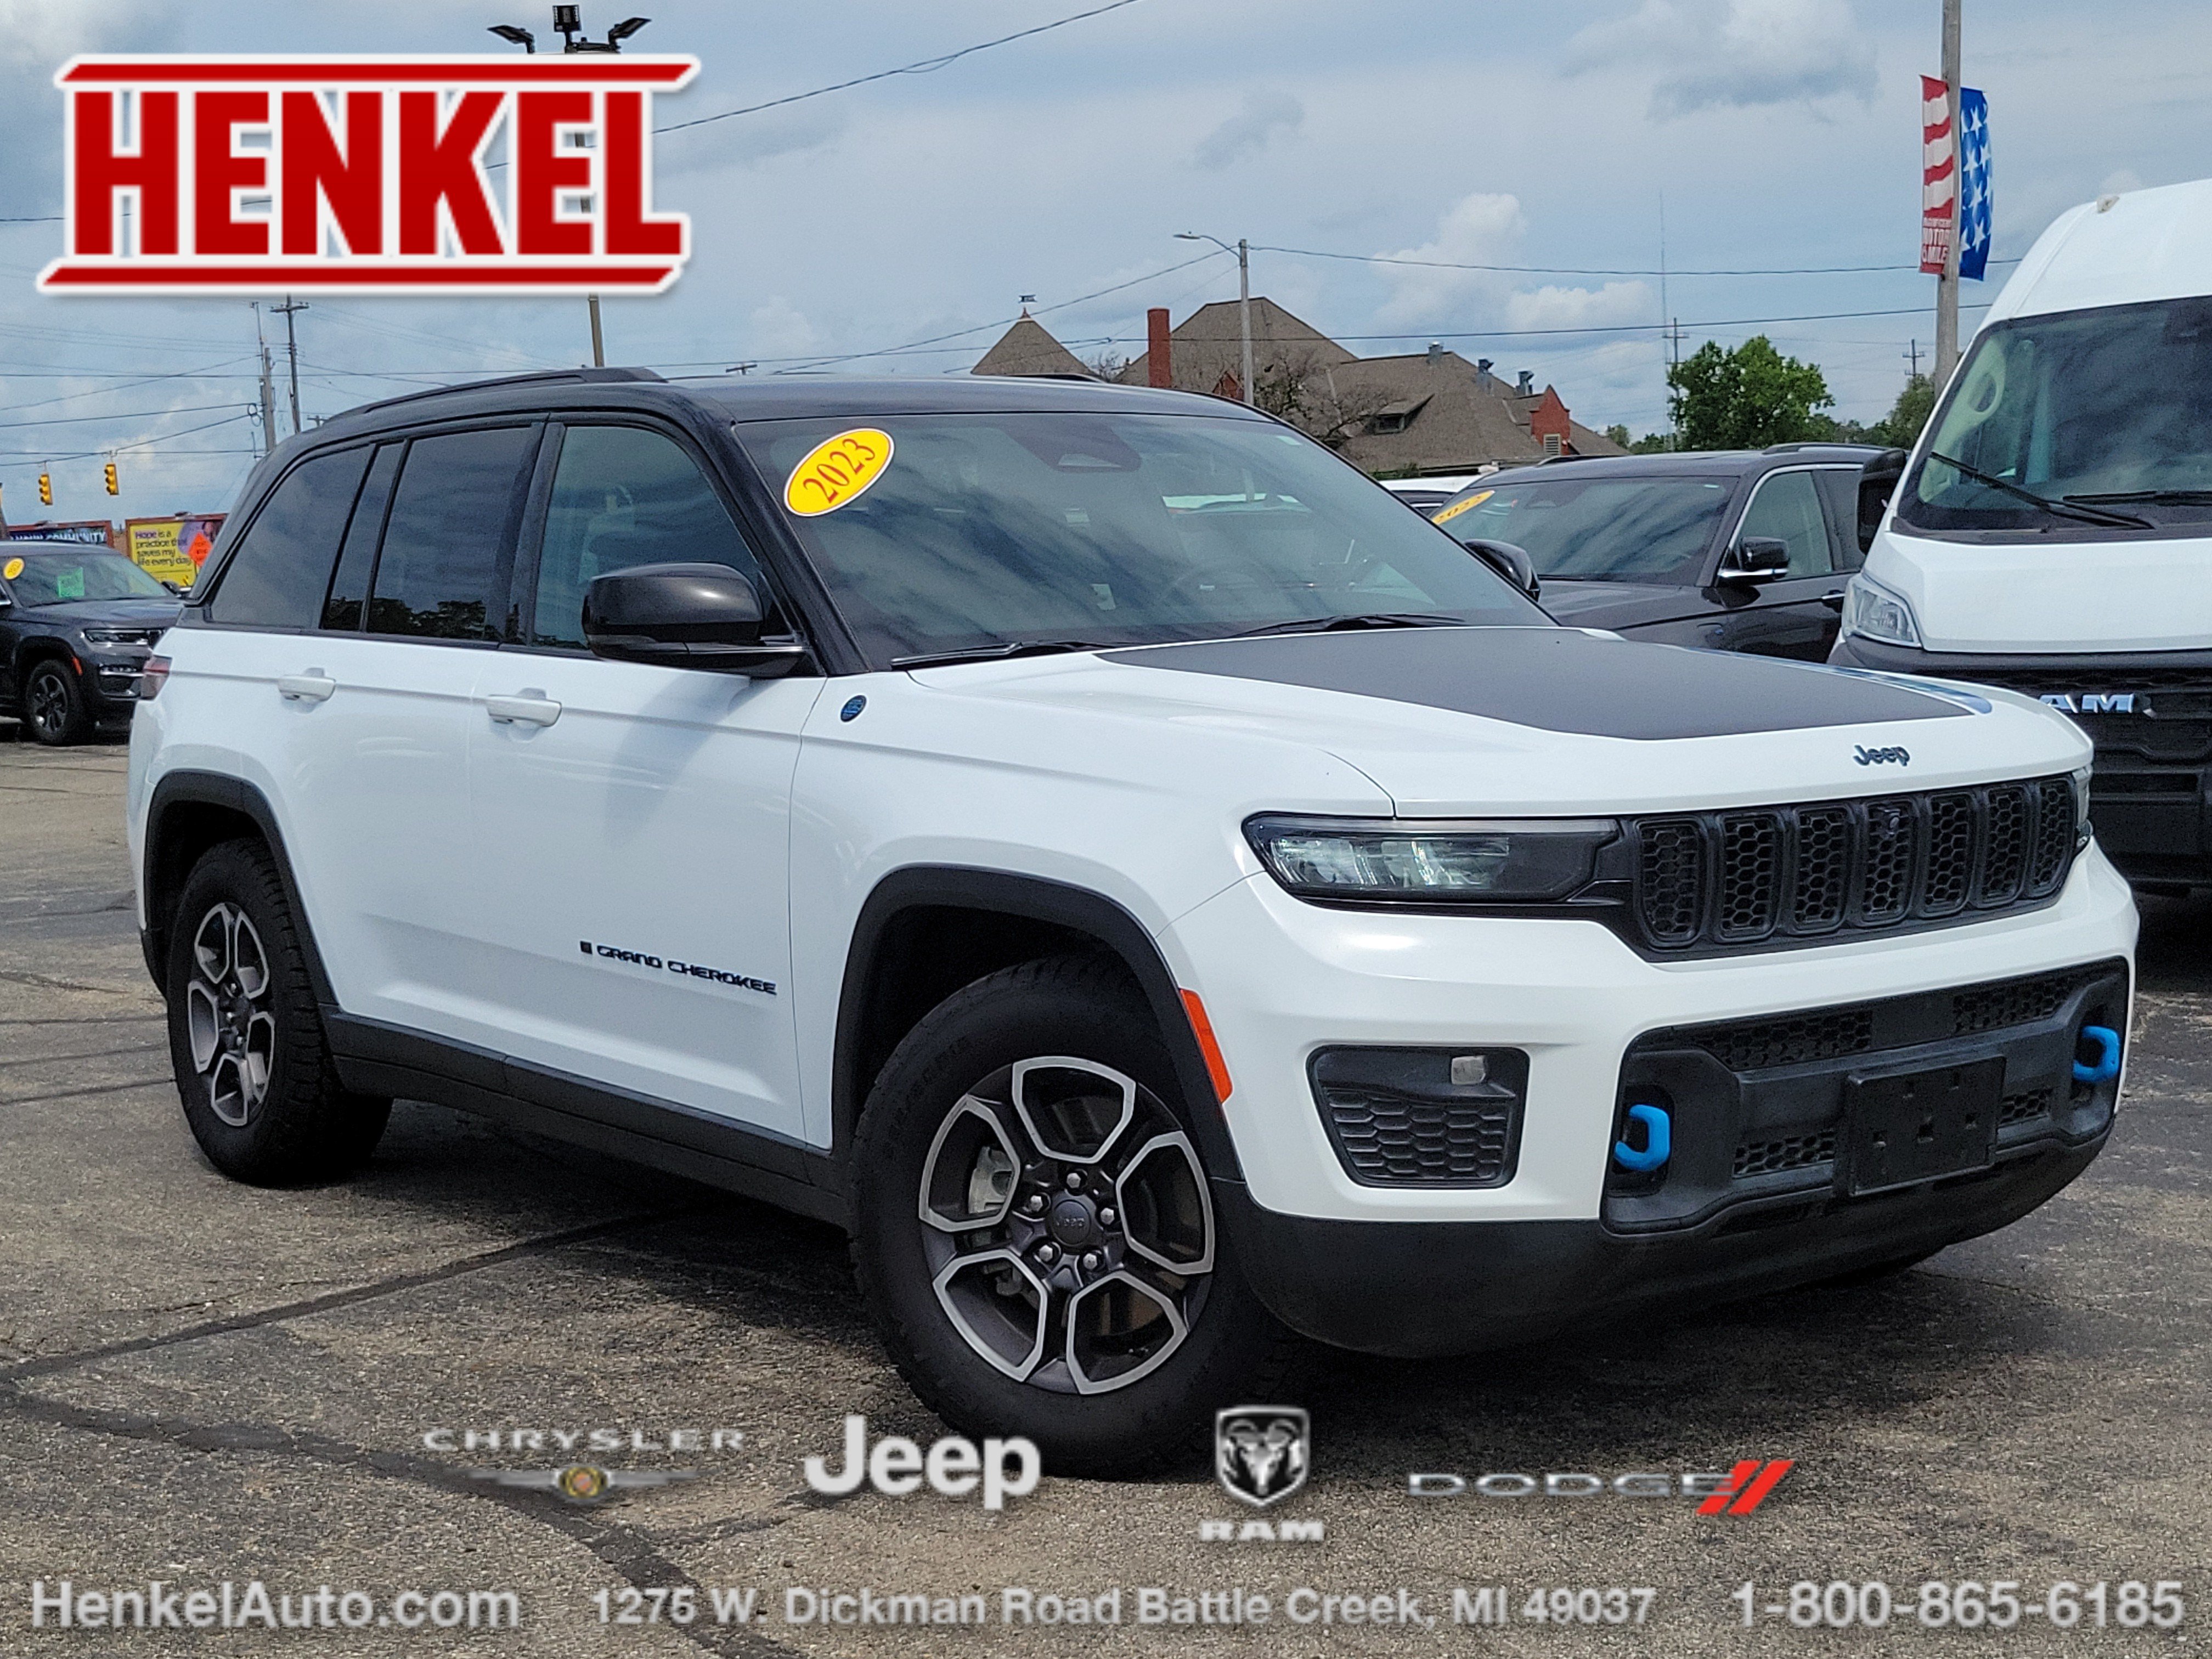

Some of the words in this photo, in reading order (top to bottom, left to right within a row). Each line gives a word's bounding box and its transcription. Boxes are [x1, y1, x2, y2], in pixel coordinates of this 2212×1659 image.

[803, 438, 876, 504] 2023
[135, 531, 157, 539] Hope
[136, 539, 170, 549] practice
[162, 549, 176, 557] my
[137, 556, 150, 566] life
[151, 558, 174, 566] every
[2038, 693, 2136, 714] AM
[1853, 744, 1910, 767] Jeep
[596, 945, 663, 969] GRAND
[667, 960, 777, 996] CHEROKEE
